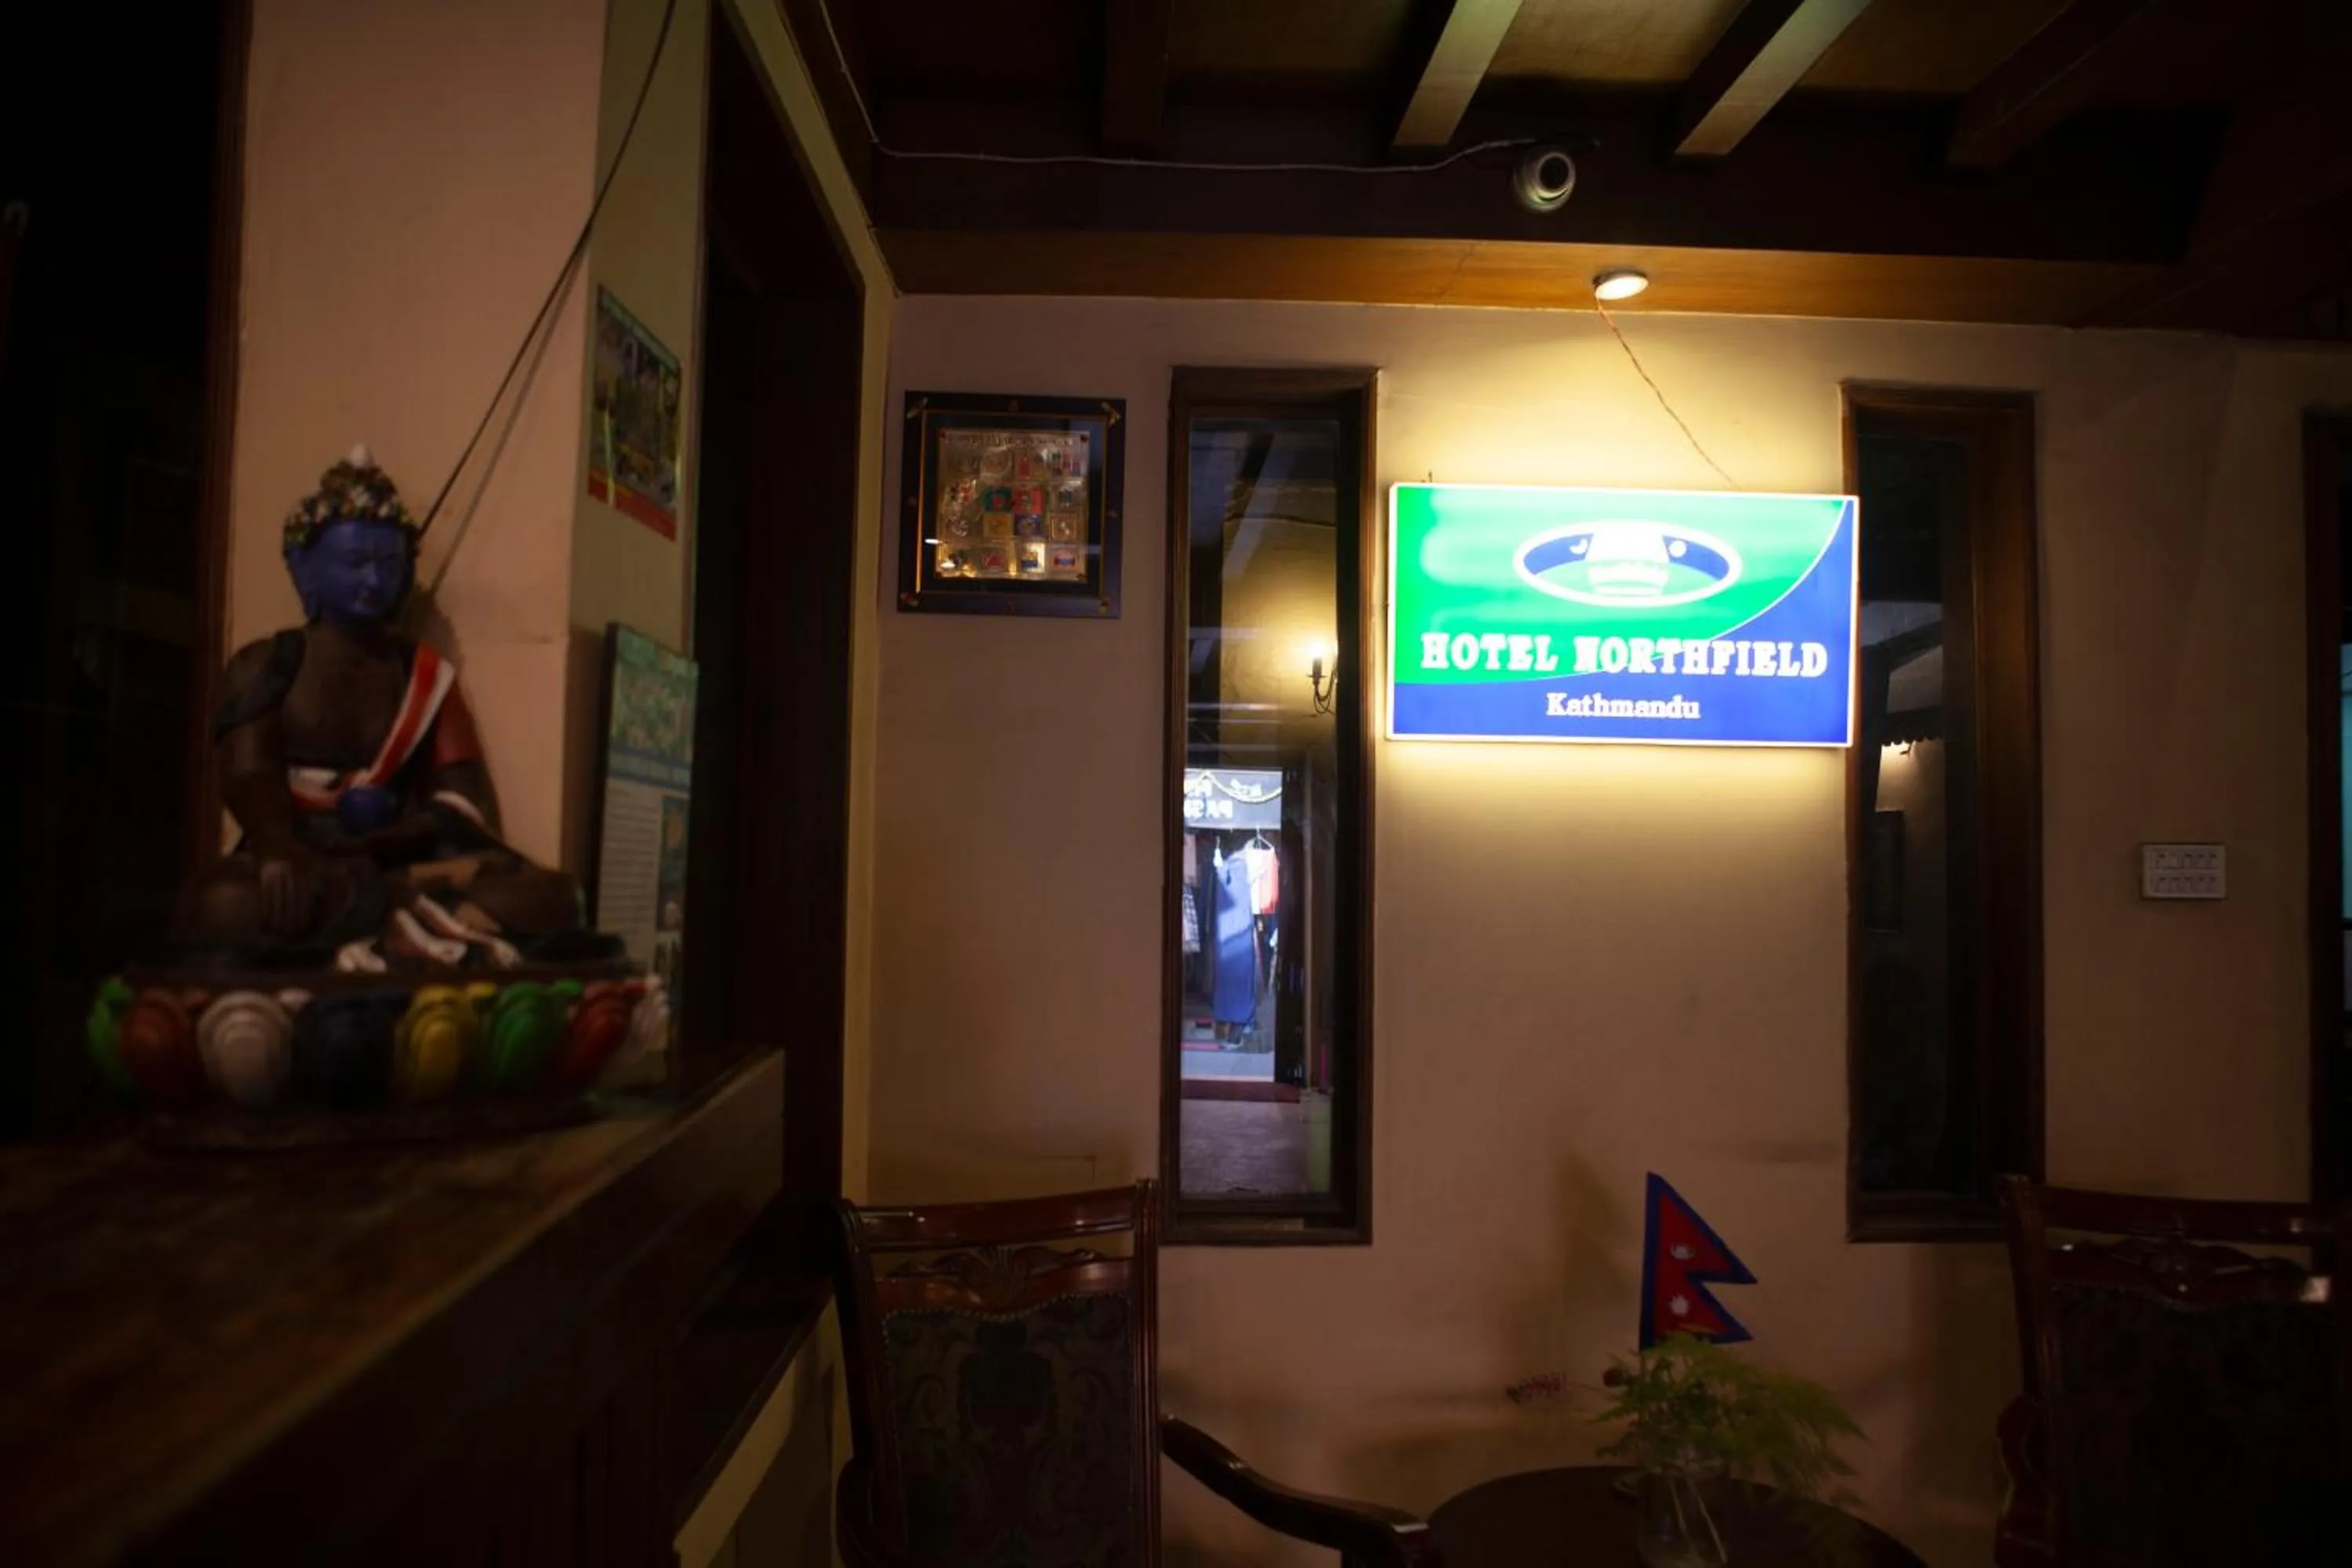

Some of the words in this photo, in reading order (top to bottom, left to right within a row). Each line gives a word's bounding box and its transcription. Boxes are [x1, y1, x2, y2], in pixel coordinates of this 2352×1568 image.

[1421, 632, 1559, 671] HOTEL
[1573, 636, 1828, 677] NORTHFIELD
[1545, 691, 1701, 719] Kathmandu
